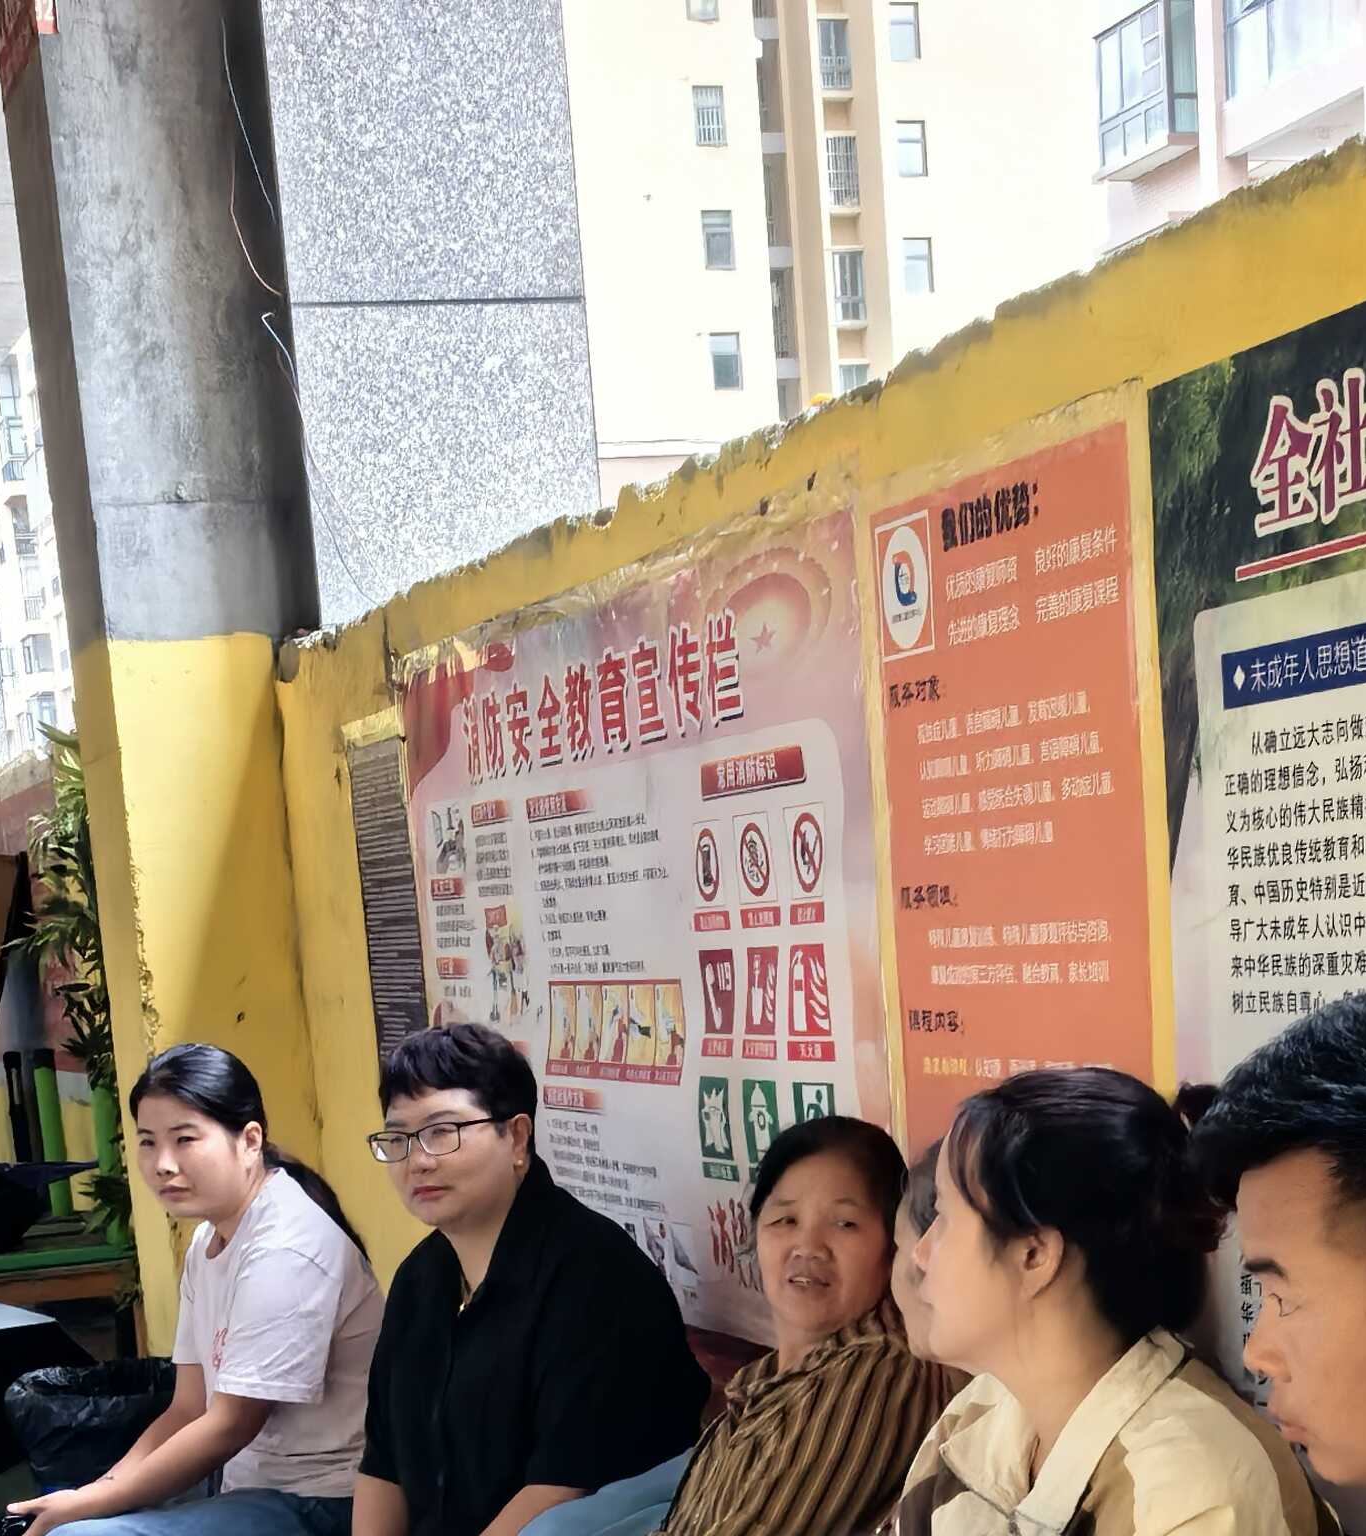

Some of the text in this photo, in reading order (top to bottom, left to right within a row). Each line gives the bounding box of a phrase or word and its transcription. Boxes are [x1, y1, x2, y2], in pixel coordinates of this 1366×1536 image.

[462, 607, 744, 785] 消防安全教育宣传栏
[716, 961, 732, 991] 119
